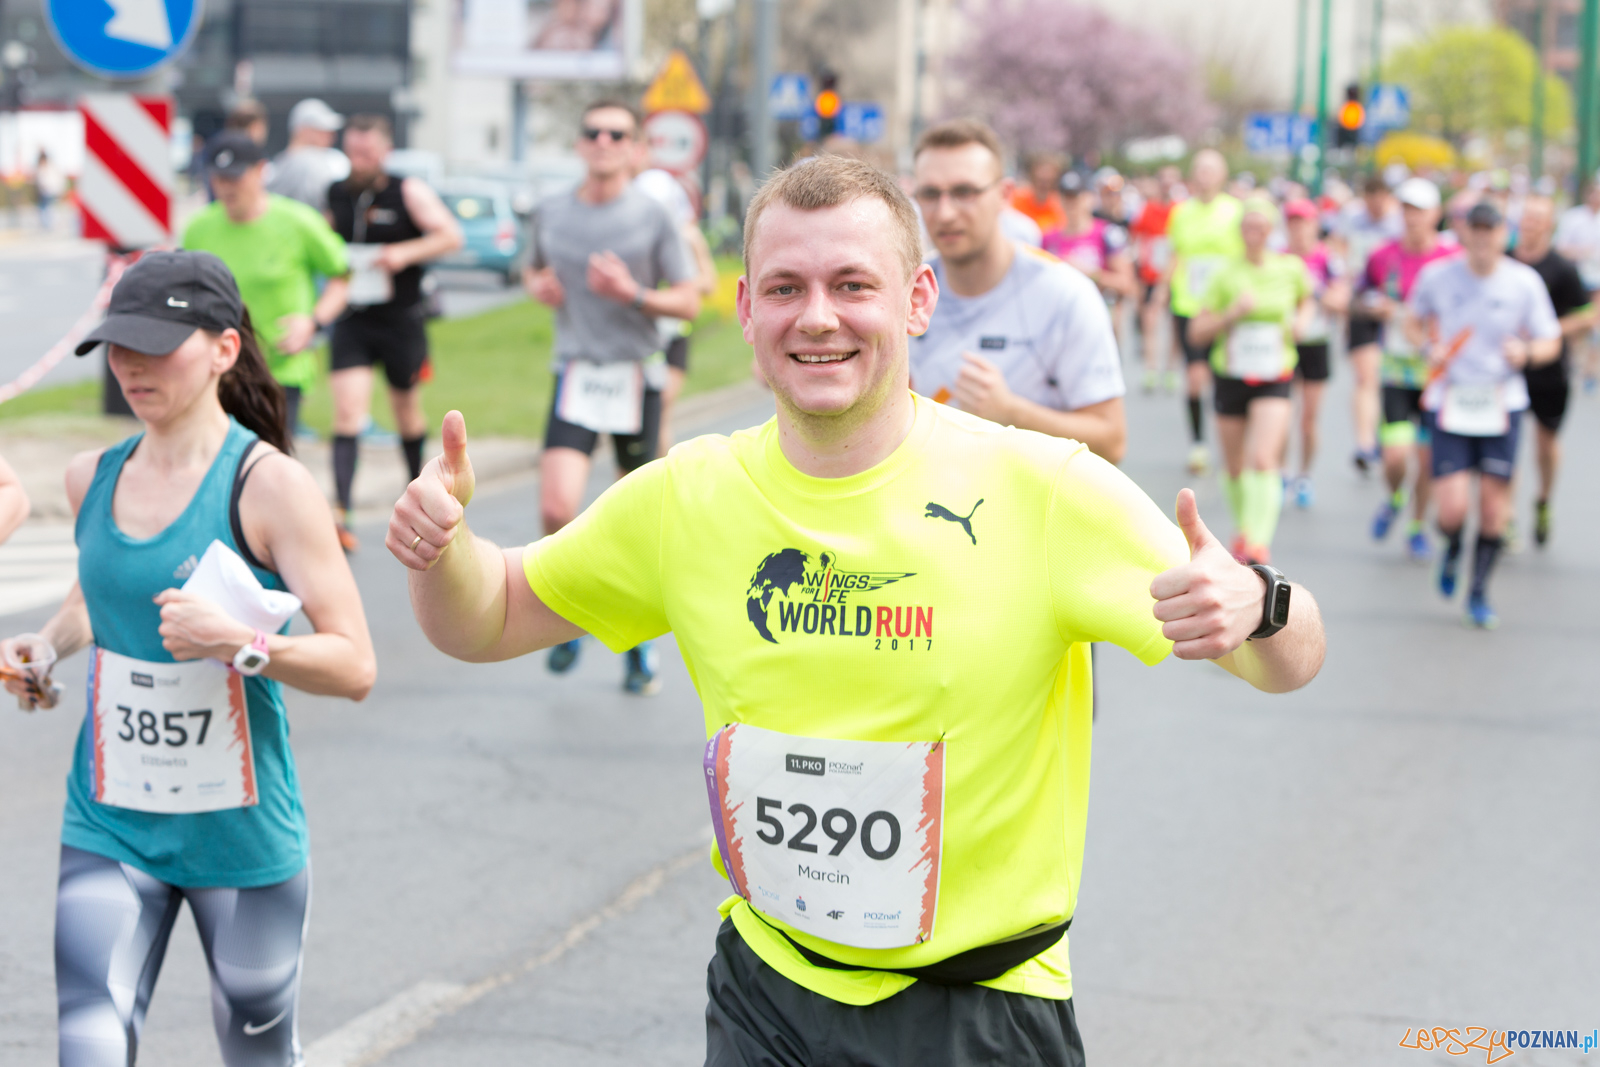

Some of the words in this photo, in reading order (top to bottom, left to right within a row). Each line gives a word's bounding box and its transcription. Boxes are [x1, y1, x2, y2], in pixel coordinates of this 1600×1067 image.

[806, 571, 870, 589] WINGS
[801, 587, 815, 595] FOR
[813, 588, 850, 604] LIFE
[875, 638, 933, 651] 2017
[117, 704, 212, 747] 3857
[756, 796, 901, 861] 5290
[798, 864, 850, 885] Marcin
